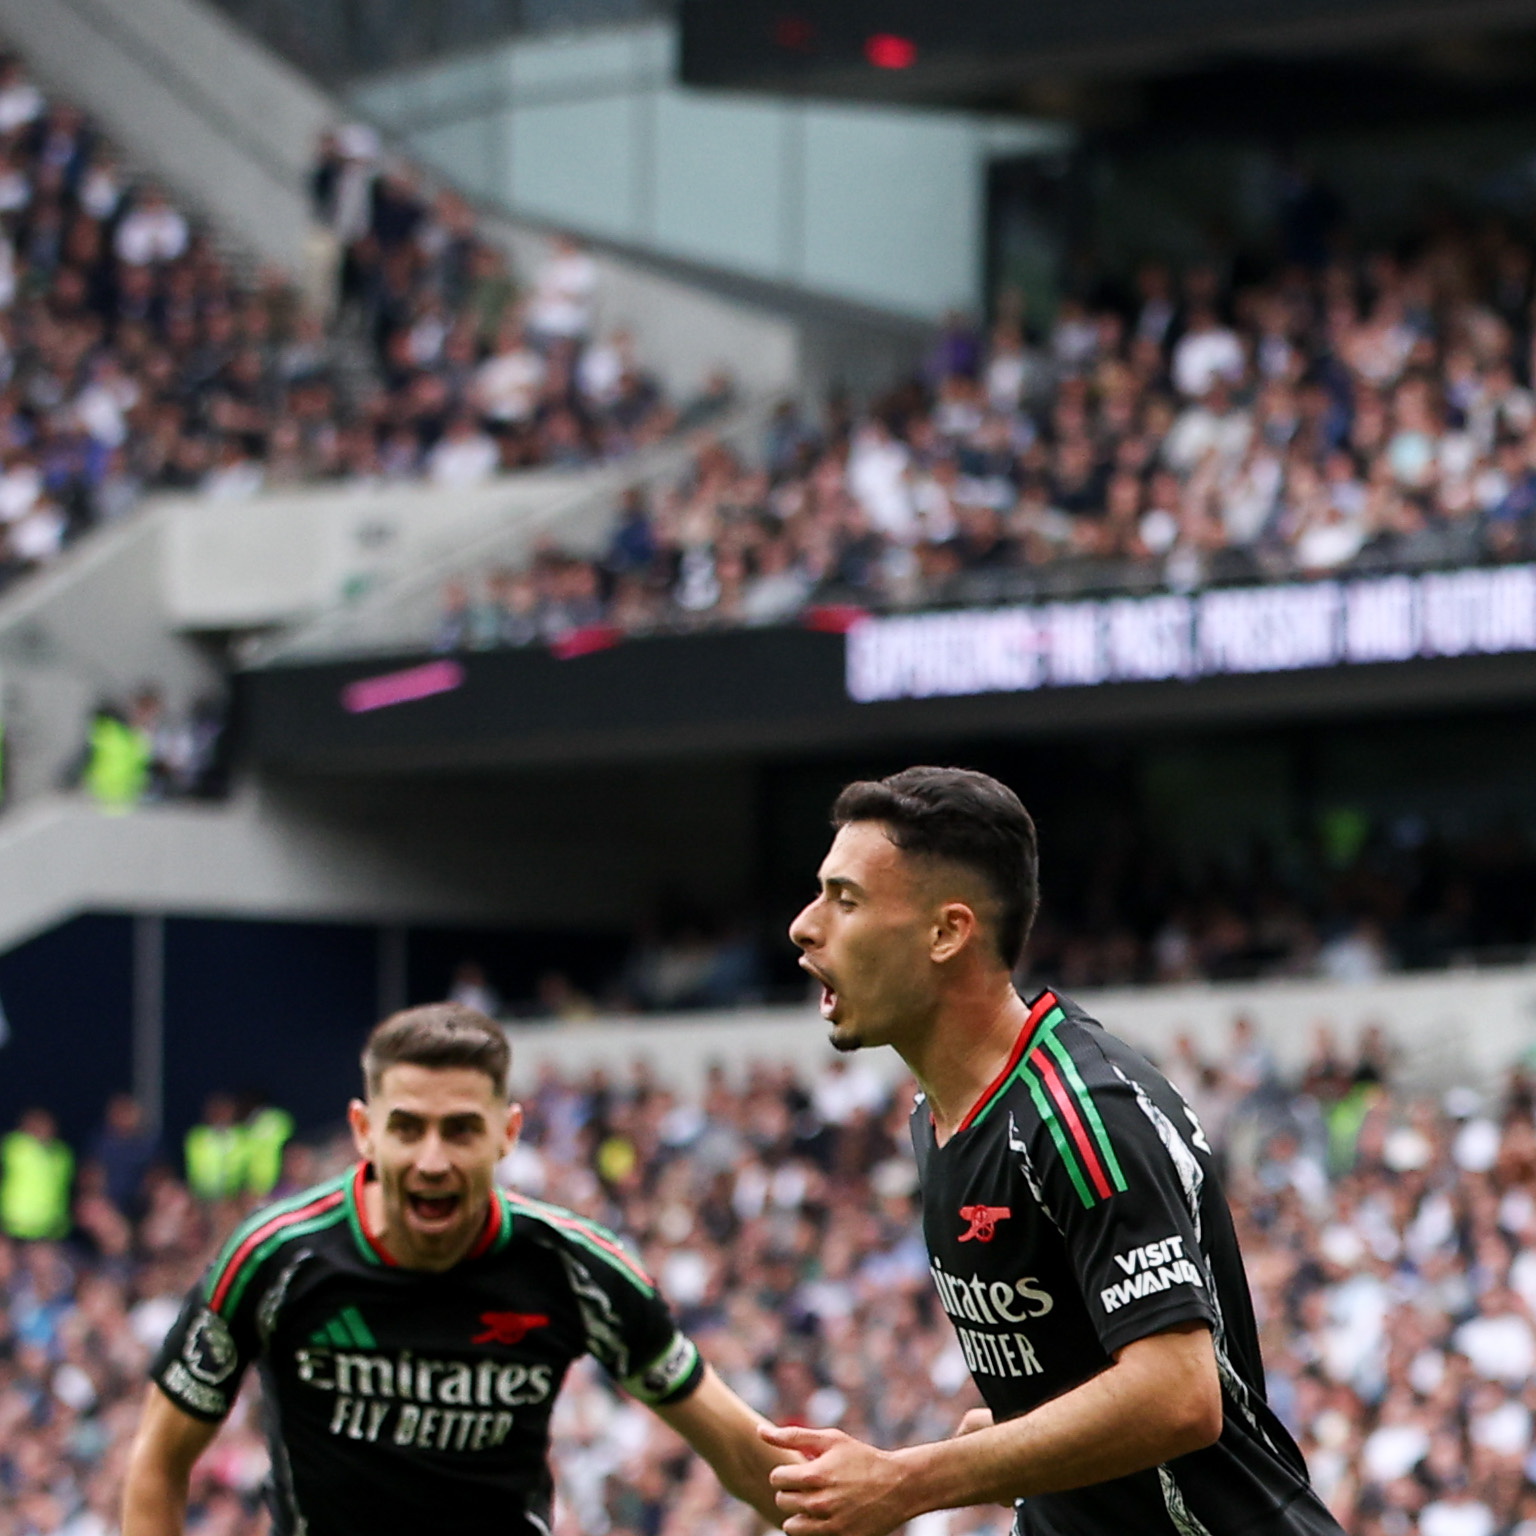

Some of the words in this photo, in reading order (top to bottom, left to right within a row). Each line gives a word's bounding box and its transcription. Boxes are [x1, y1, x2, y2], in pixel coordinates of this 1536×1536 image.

[1113, 1235, 1184, 1276] VISIT
[930, 1255, 1055, 1325] irates
[296, 1346, 553, 1407] Emirates
[957, 1326, 1045, 1378] BETTER
[331, 1397, 389, 1442] FLY
[394, 1404, 514, 1451] BETTER
